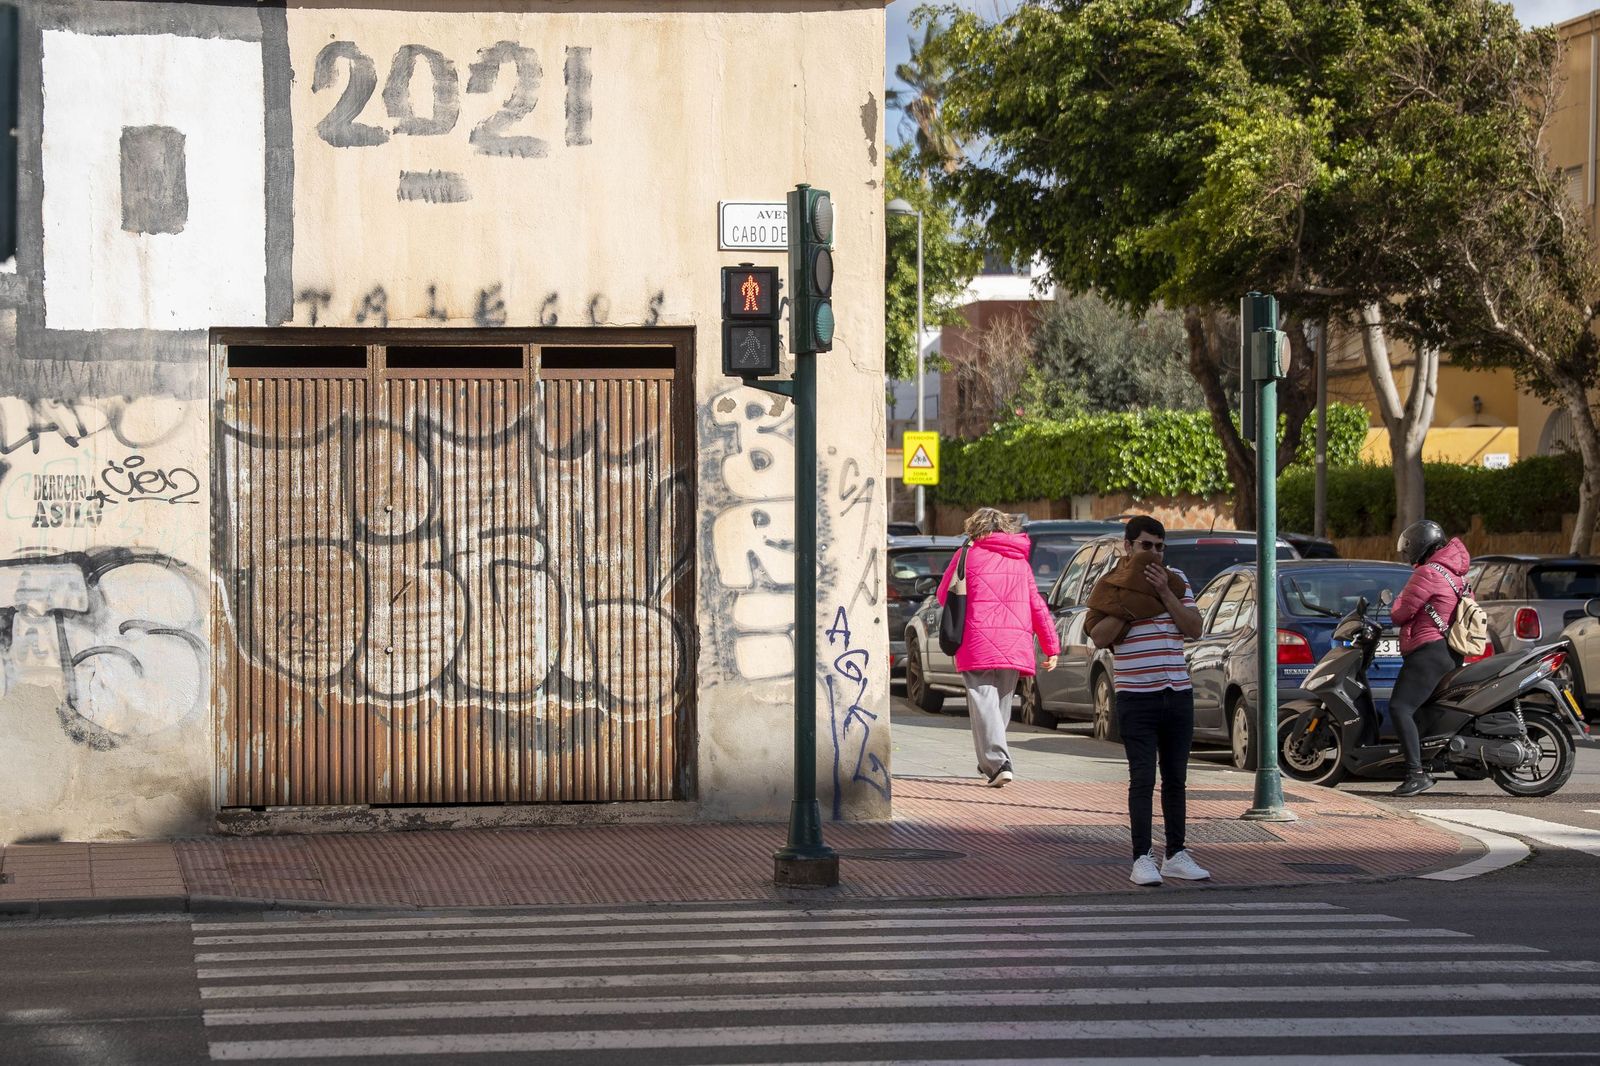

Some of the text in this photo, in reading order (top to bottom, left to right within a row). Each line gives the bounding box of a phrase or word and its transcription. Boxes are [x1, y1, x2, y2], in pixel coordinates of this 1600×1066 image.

[311, 40, 593, 158] 2021
[732, 225, 787, 243] CABO DE
[33, 474, 87, 501] DERECHO
[32, 501, 103, 529] ASILO
